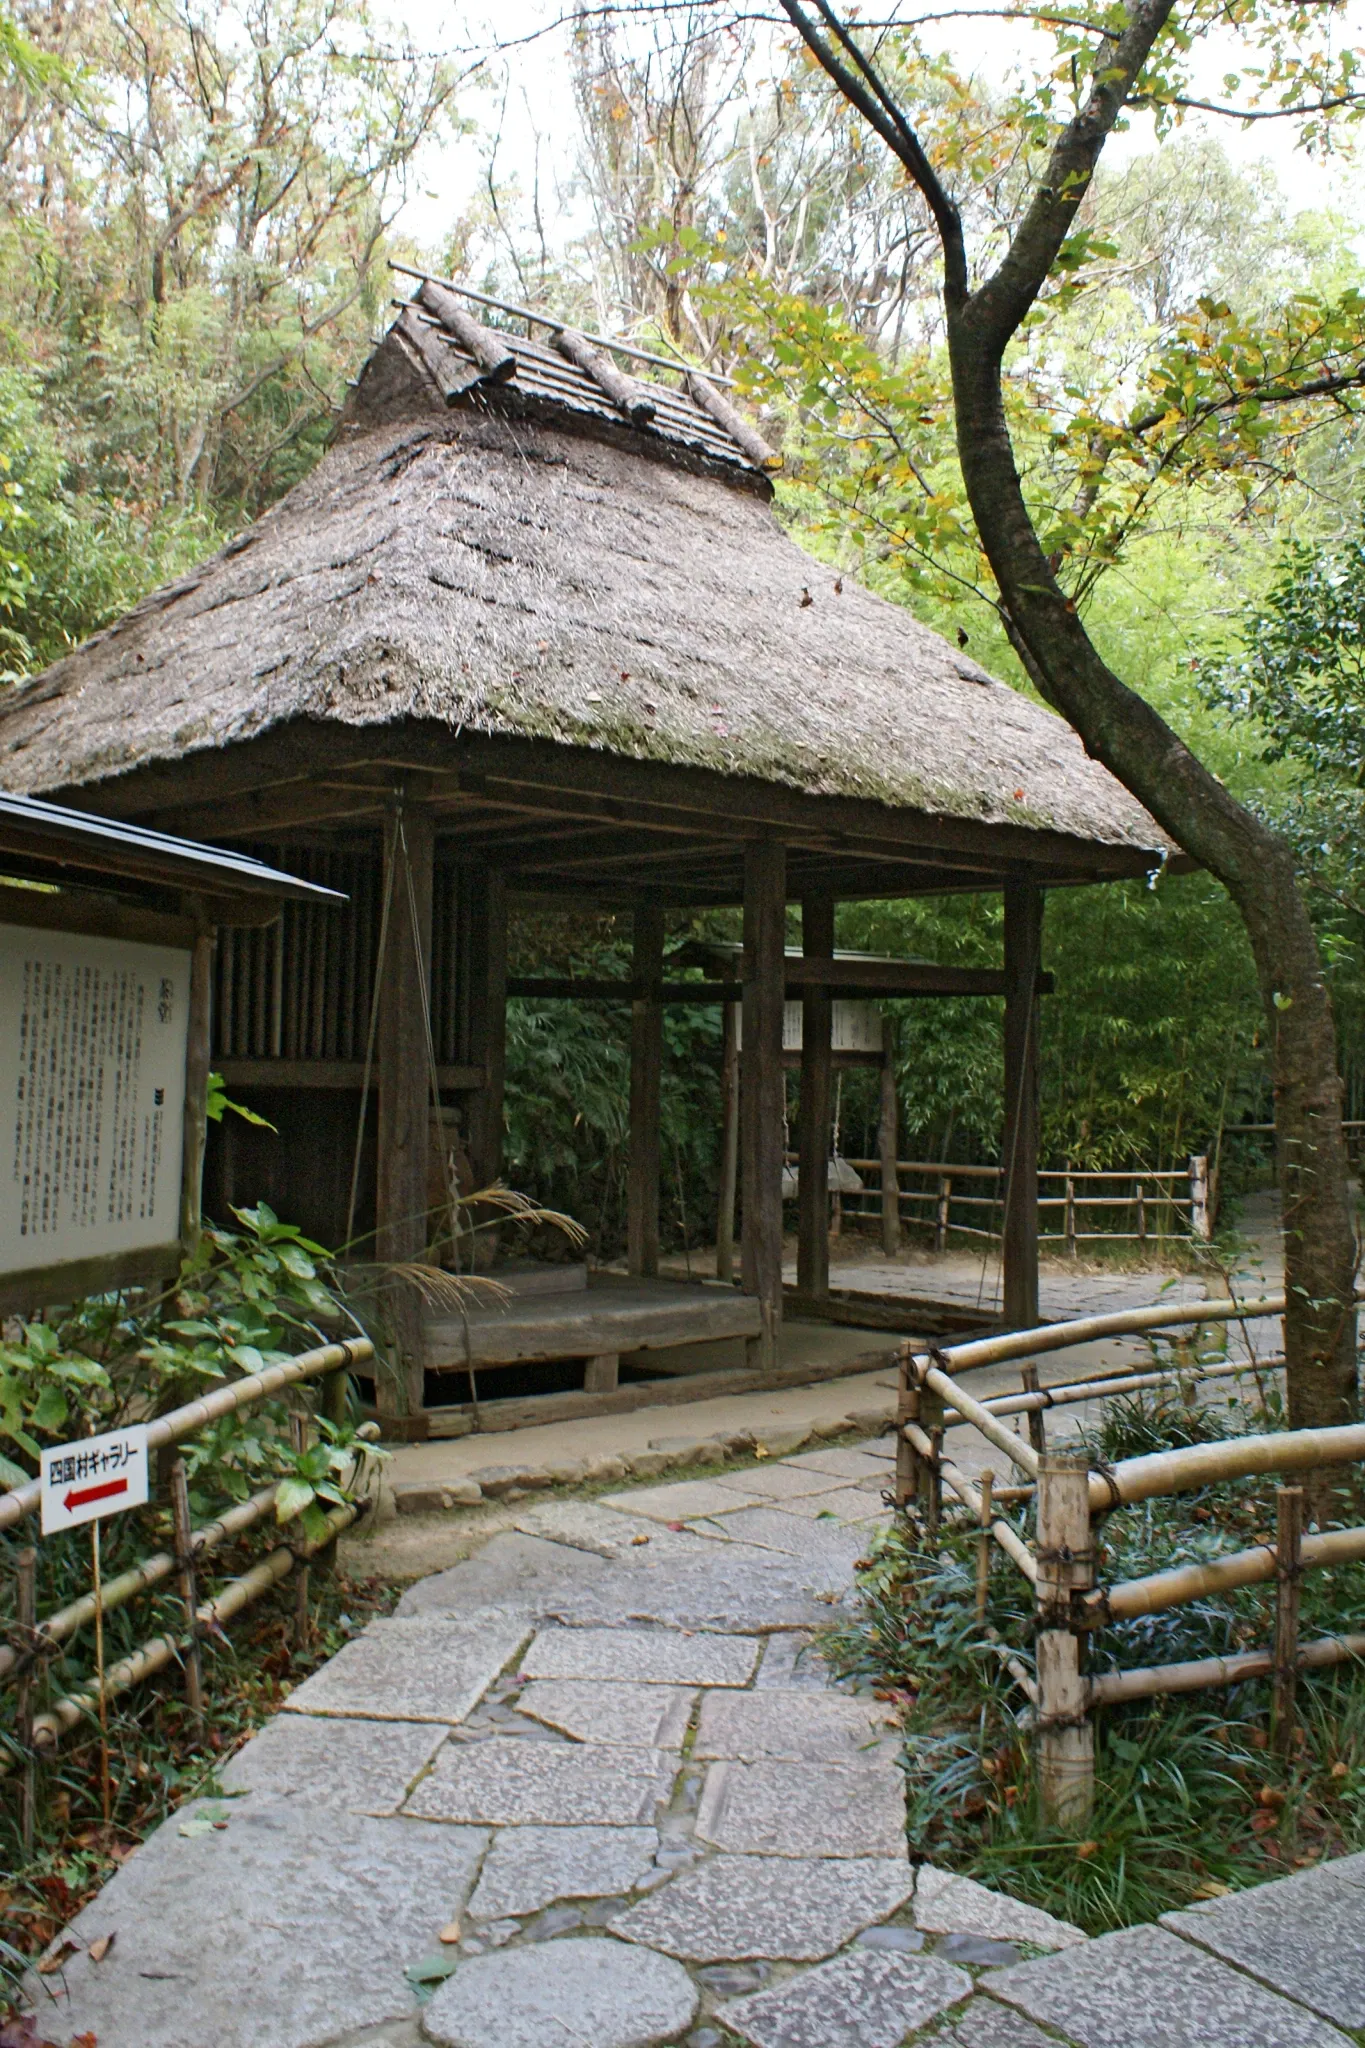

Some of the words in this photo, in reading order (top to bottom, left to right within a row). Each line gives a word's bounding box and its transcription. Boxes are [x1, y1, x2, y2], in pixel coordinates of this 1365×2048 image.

[50, 1441, 138, 1486] 四国村ギャラリー
